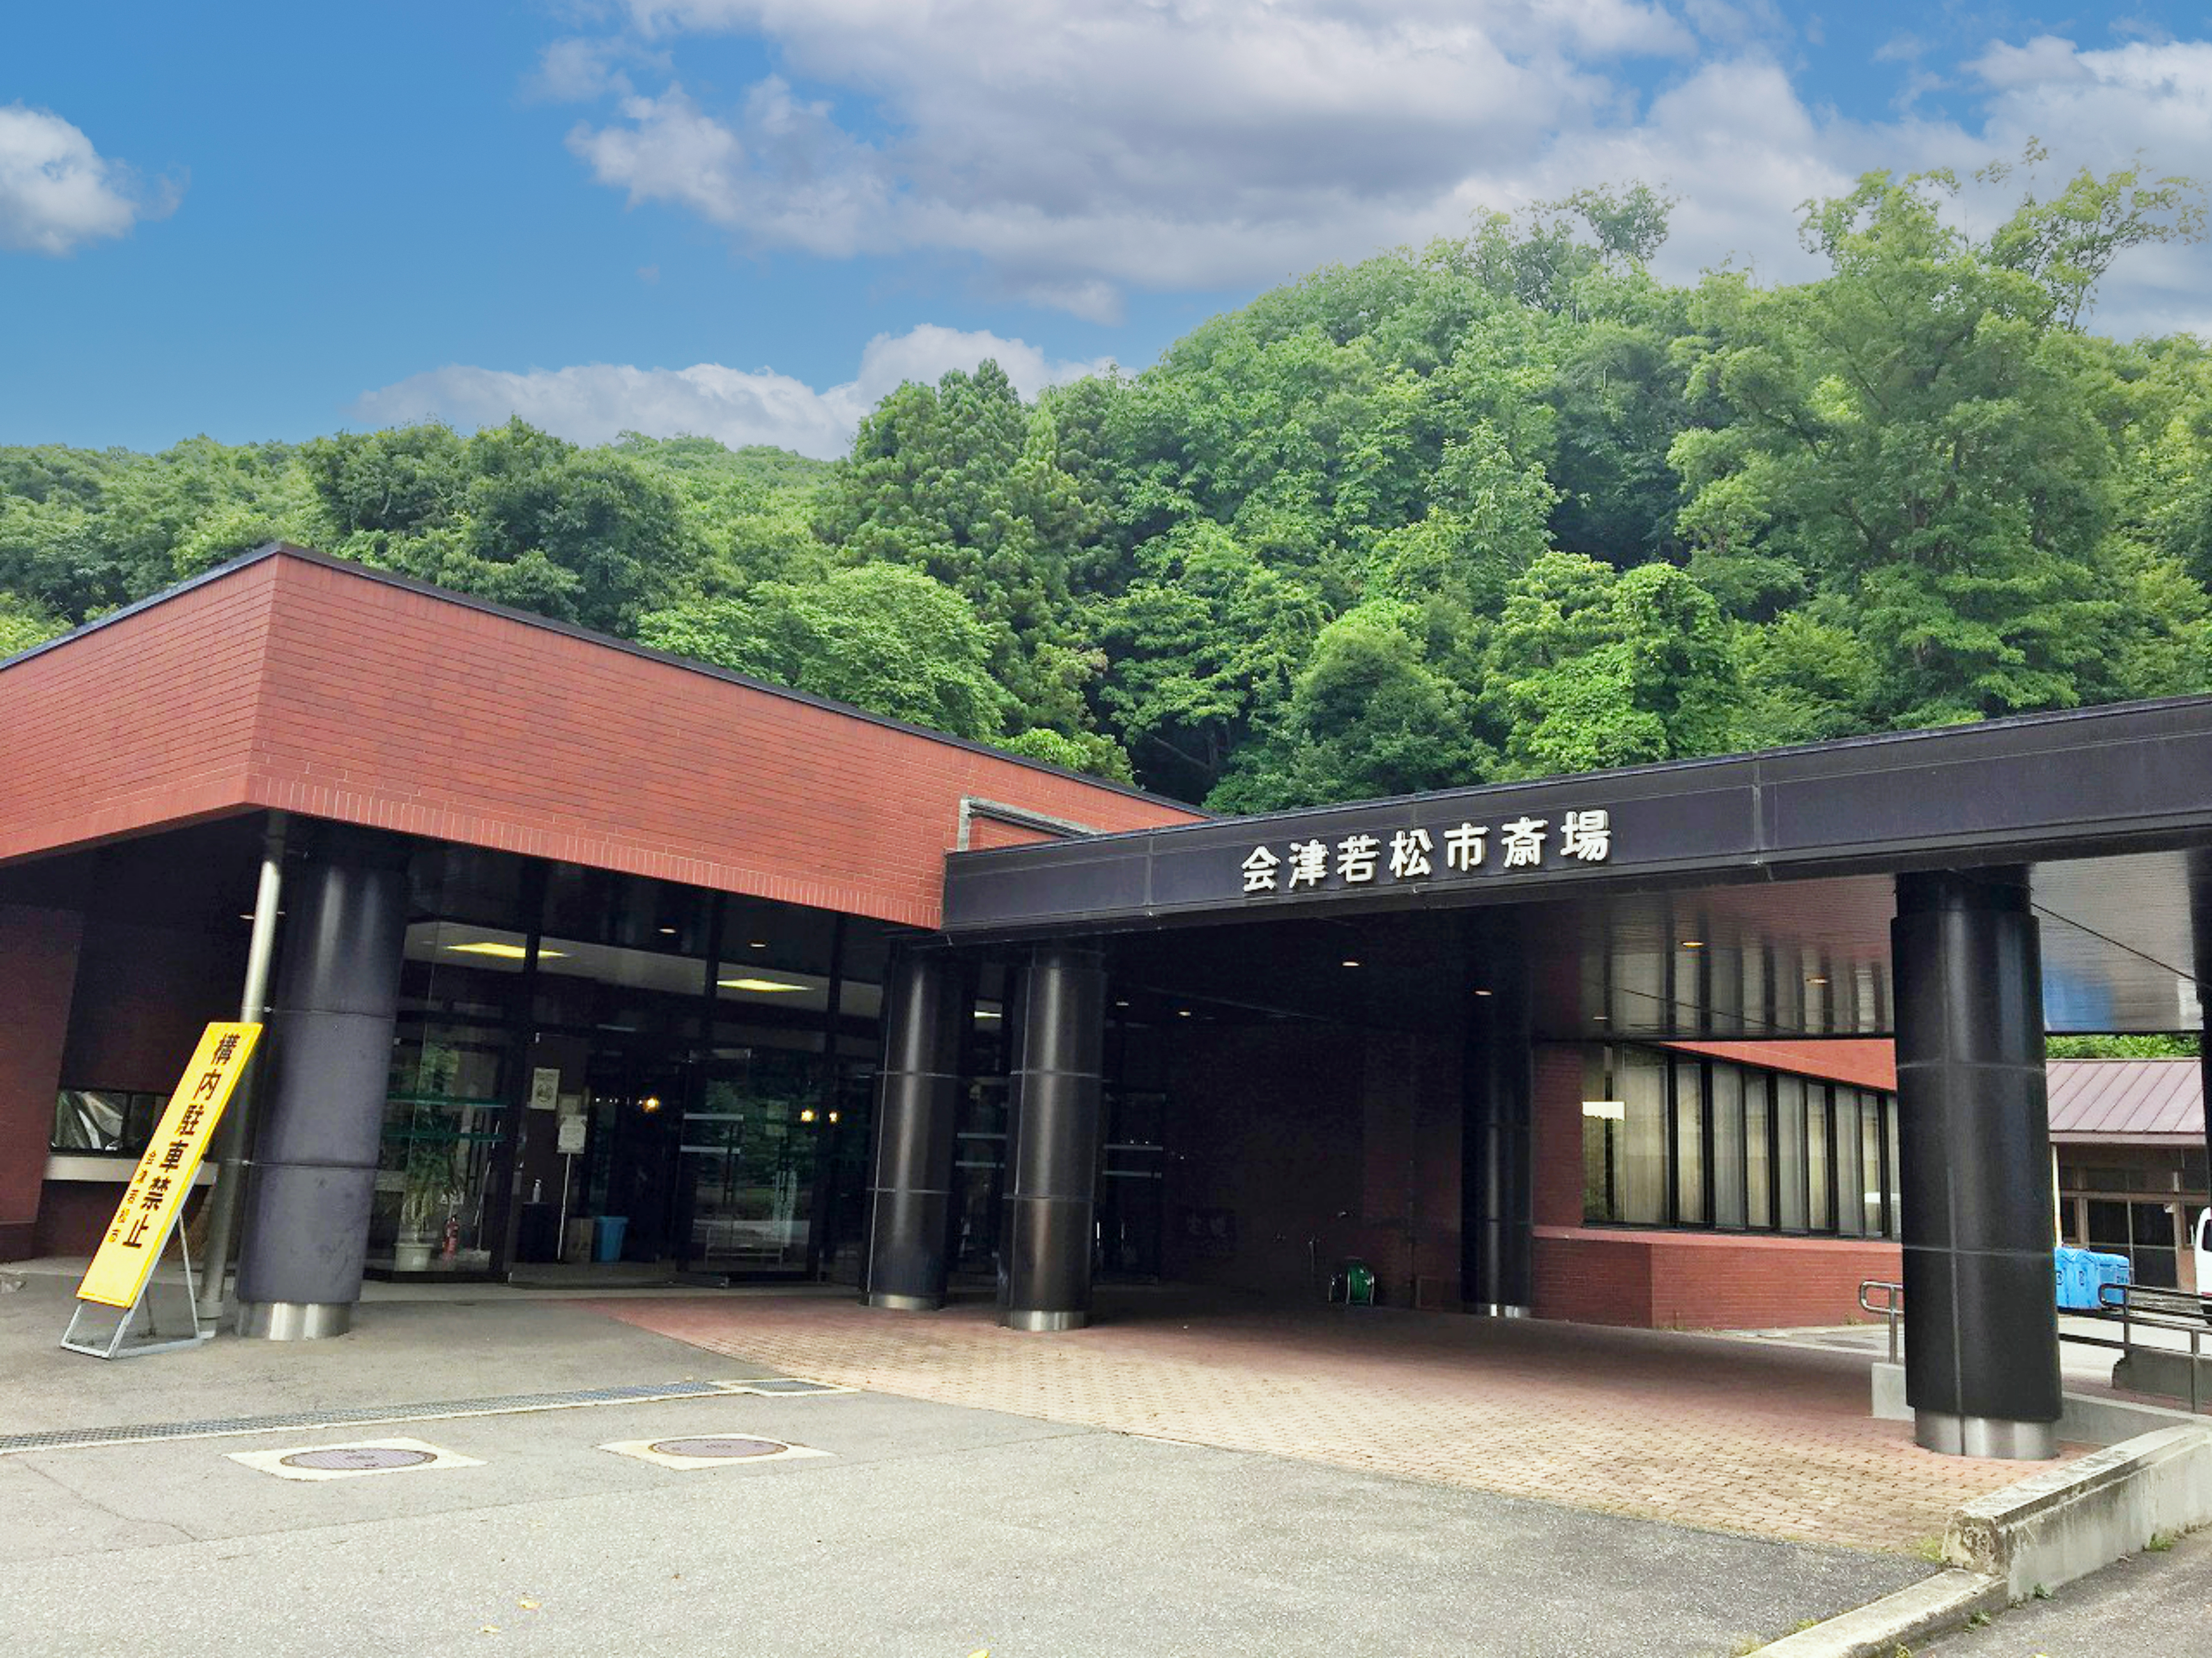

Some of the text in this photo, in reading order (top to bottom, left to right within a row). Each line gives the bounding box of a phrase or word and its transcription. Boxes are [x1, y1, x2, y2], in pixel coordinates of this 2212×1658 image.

[1241, 809, 1612, 892] 会津若松市斎場
[122, 1034, 240, 1249] 構内駐車禁止
